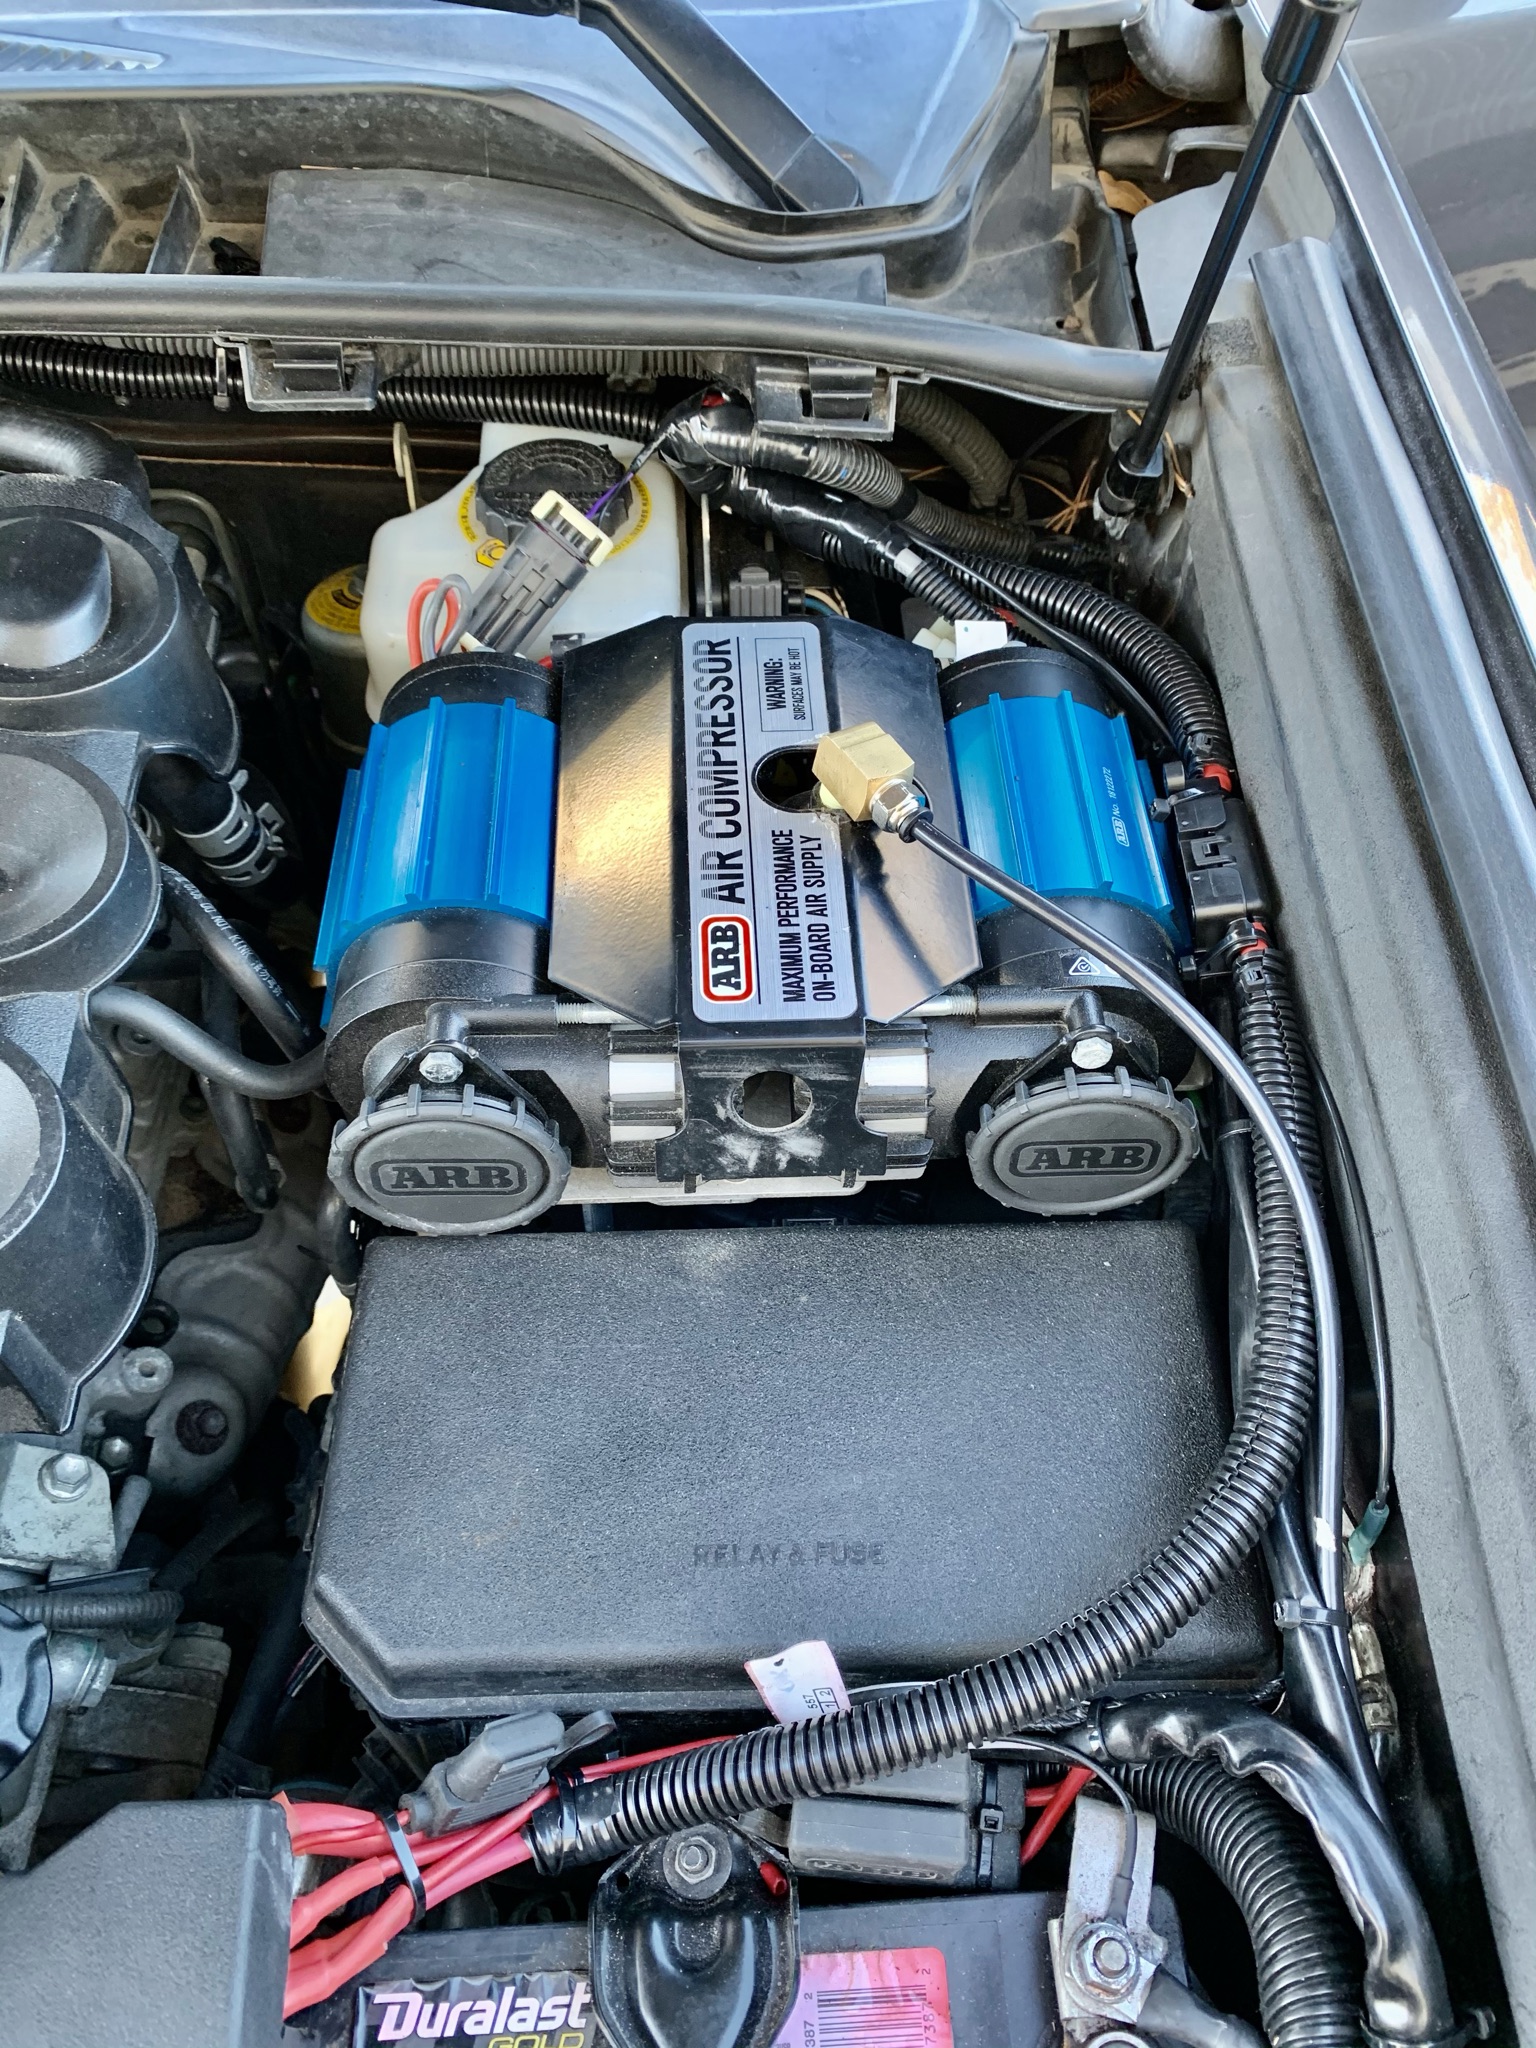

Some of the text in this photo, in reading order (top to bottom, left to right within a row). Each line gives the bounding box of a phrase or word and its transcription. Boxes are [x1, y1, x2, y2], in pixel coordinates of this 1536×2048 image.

[763, 657, 787, 711] WARNING:
[788, 648, 806, 721] SURFACES MAY BE HOT
[692, 637, 746, 905] AIR COMPRESSOR
[211, 915, 232, 931] NOT
[228, 934, 253, 958] KINK
[771, 829, 806, 1003] MAXIMUM PERFORMANCE
[800, 835, 837, 1002] ON-BOARD AIR SUPPLY
[710, 923, 742, 991] ARB
[390, 1166, 514, 1190] ARB
[1025, 1146, 1146, 1171] ARB
[815, 1541, 887, 1566] FUSE
[802, 1694, 819, 1709] 557
[820, 1688, 832, 1697] 2
[373, 1982, 591, 2042] Duralast
[804, 1992, 813, 2000] 2
